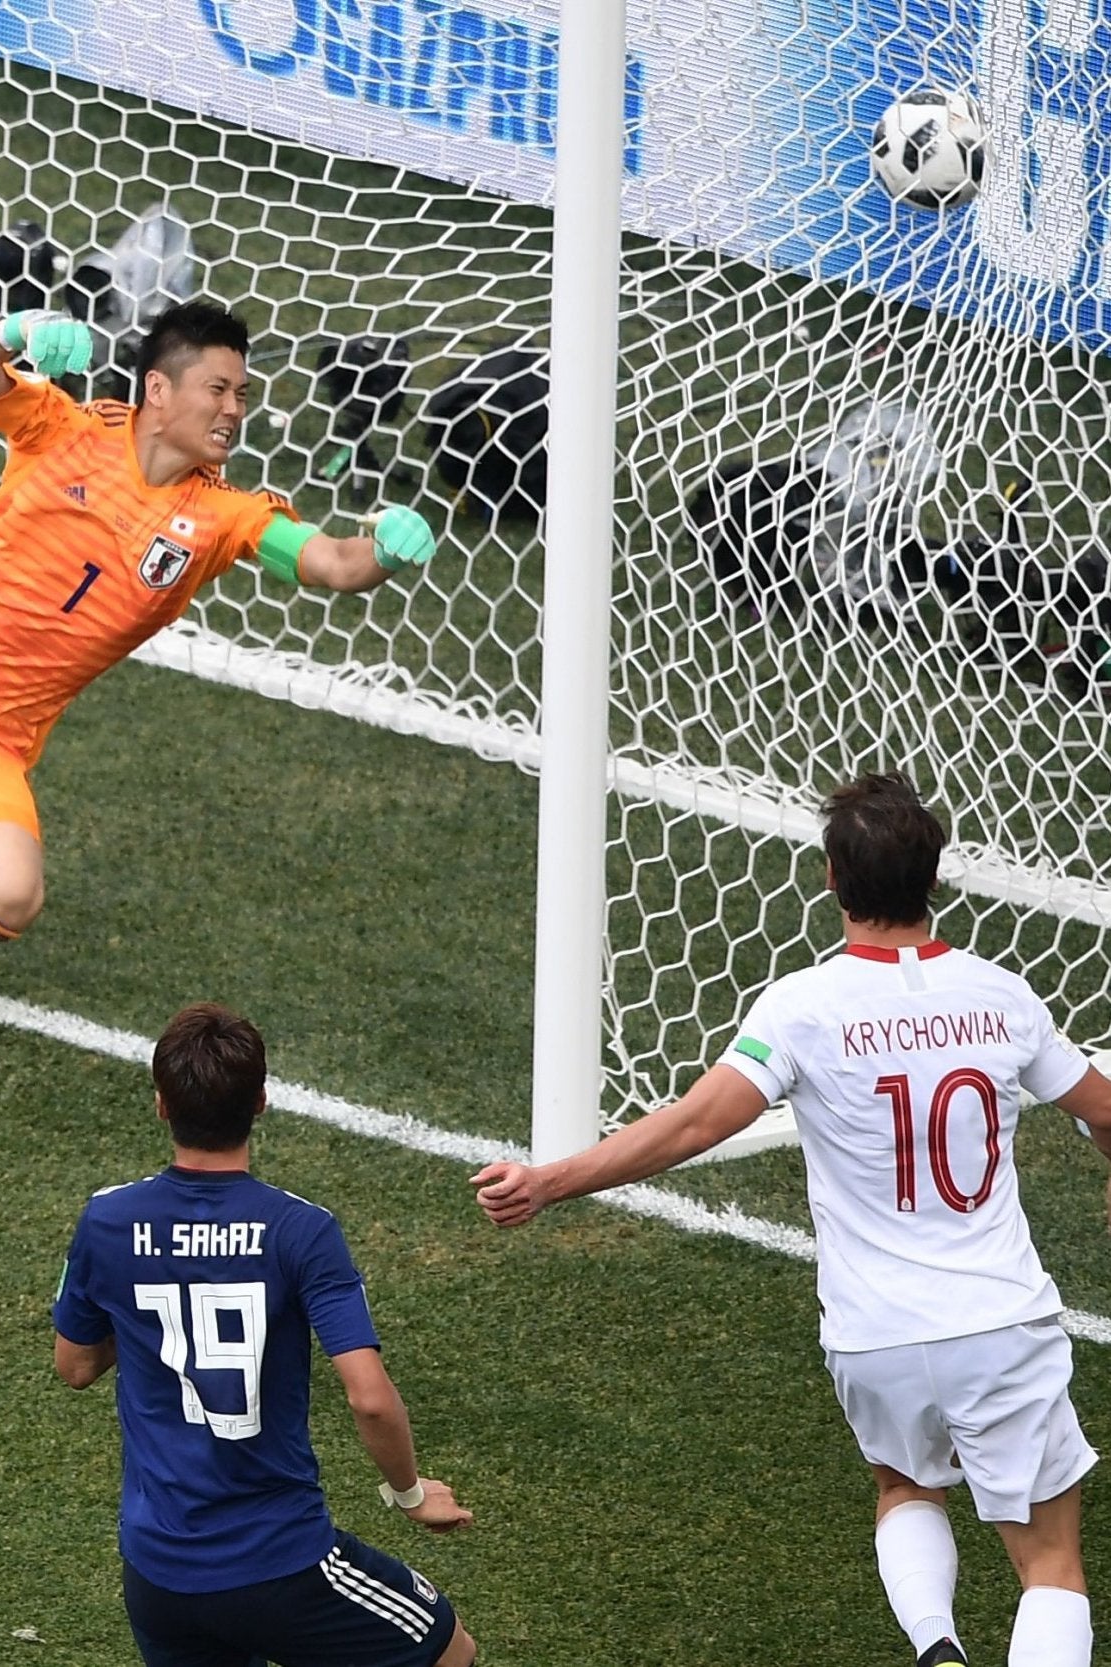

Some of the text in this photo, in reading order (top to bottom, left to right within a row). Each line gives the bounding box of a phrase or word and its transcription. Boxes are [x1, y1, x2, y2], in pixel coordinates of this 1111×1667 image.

[62, 561, 102, 613] 1
[842, 1011, 1011, 1057] KRYCHOWIAK
[873, 1067, 1000, 1213] 10
[133, 1222, 266, 1257] H. SAKAI
[133, 1282, 267, 1440] 19
